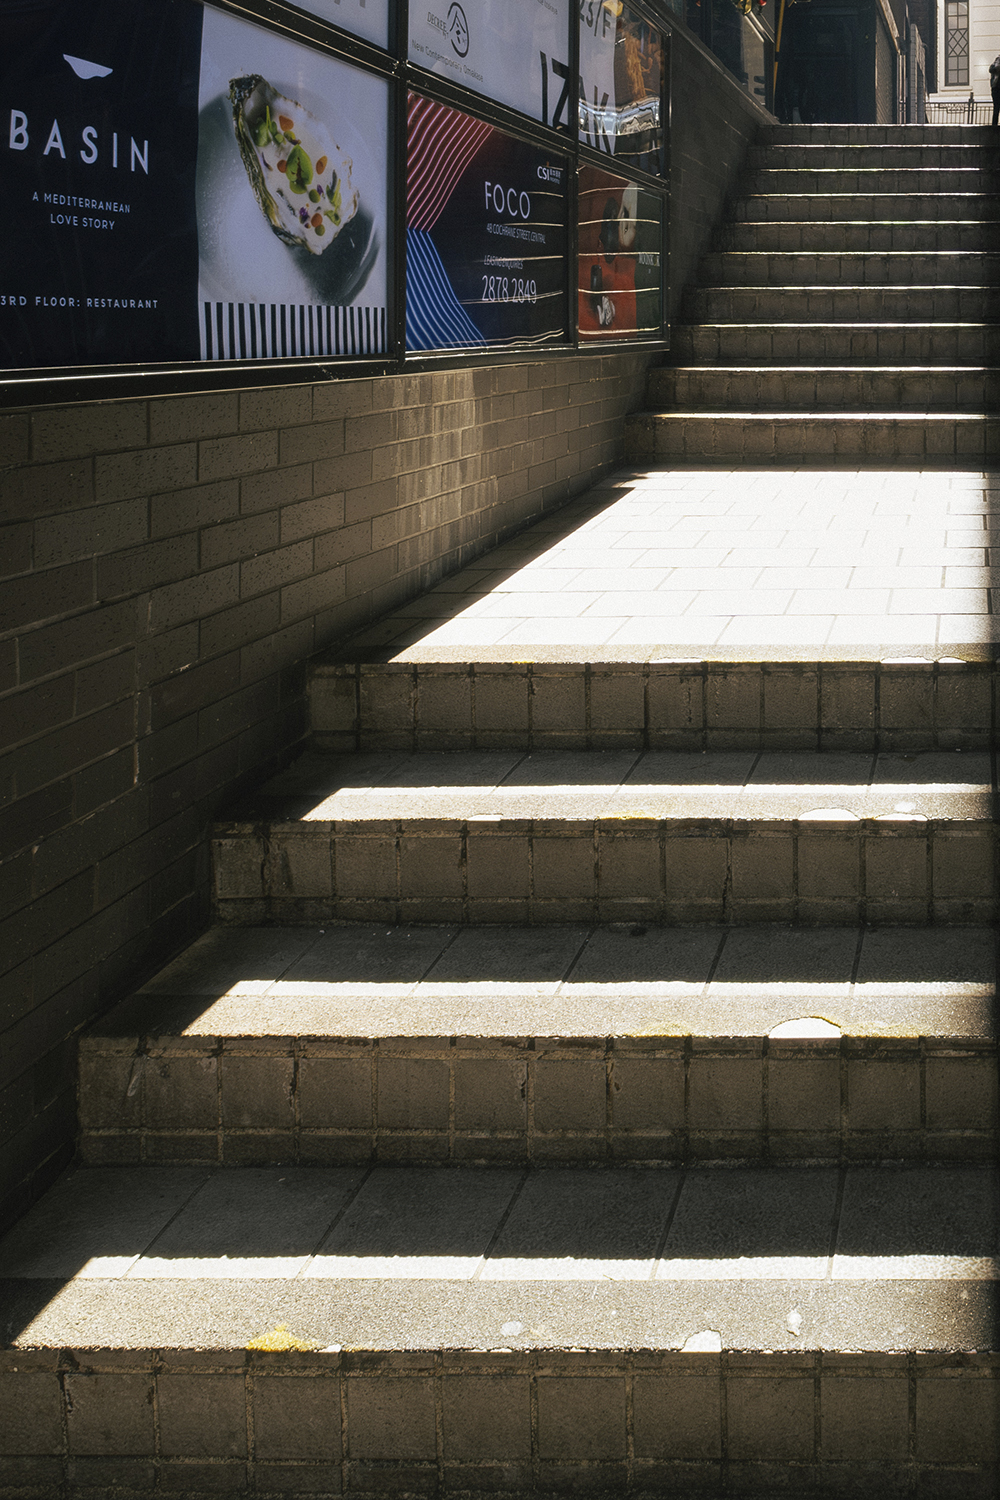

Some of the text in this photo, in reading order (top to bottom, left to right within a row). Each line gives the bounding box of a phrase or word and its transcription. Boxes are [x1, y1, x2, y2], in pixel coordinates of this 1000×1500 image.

[427, 11, 447, 32] DECREE
[411, 39, 484, 82] New Contemporary Omakase
[9, 109, 149, 175] BASIN
[537, 165, 550, 181] CSI
[32, 191, 131, 214] A MEDITERRANEAN
[484, 180, 531, 219] FOCO
[50, 213, 116, 230] LOVE STORY
[481, 275, 537, 304] 2878 2849
[35, 296, 81, 307] FLOOR:
[86, 298, 158, 309] RESTAURANT
